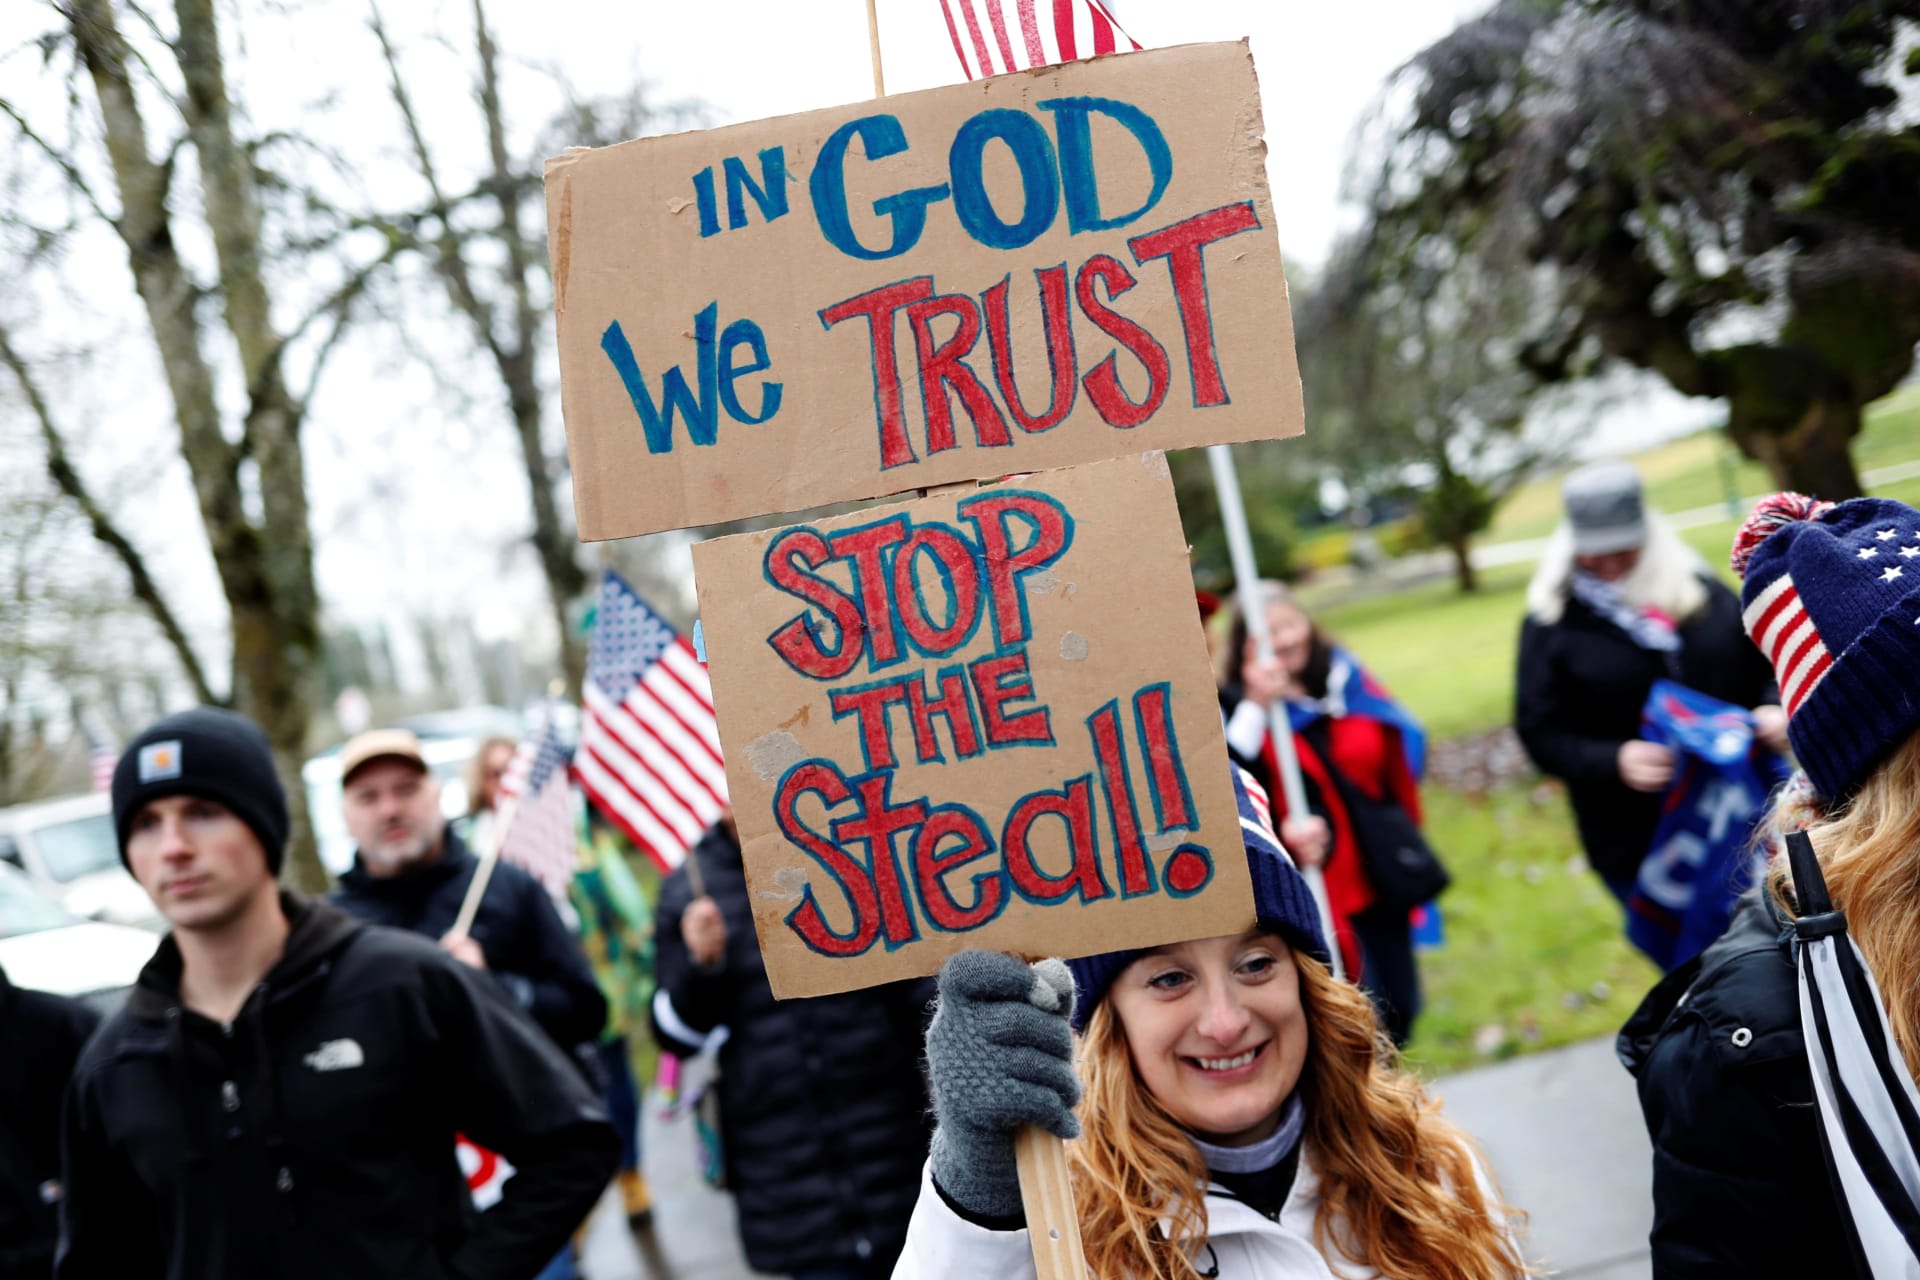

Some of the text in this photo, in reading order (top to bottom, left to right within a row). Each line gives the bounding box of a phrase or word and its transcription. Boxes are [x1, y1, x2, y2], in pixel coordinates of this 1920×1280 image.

[692, 95, 1174, 261] IN GOD
[601, 200, 1262, 472] We TRUST
[763, 489, 1075, 680] STOP
[827, 648, 1057, 773] THE
[773, 681, 1215, 958] Steal!
